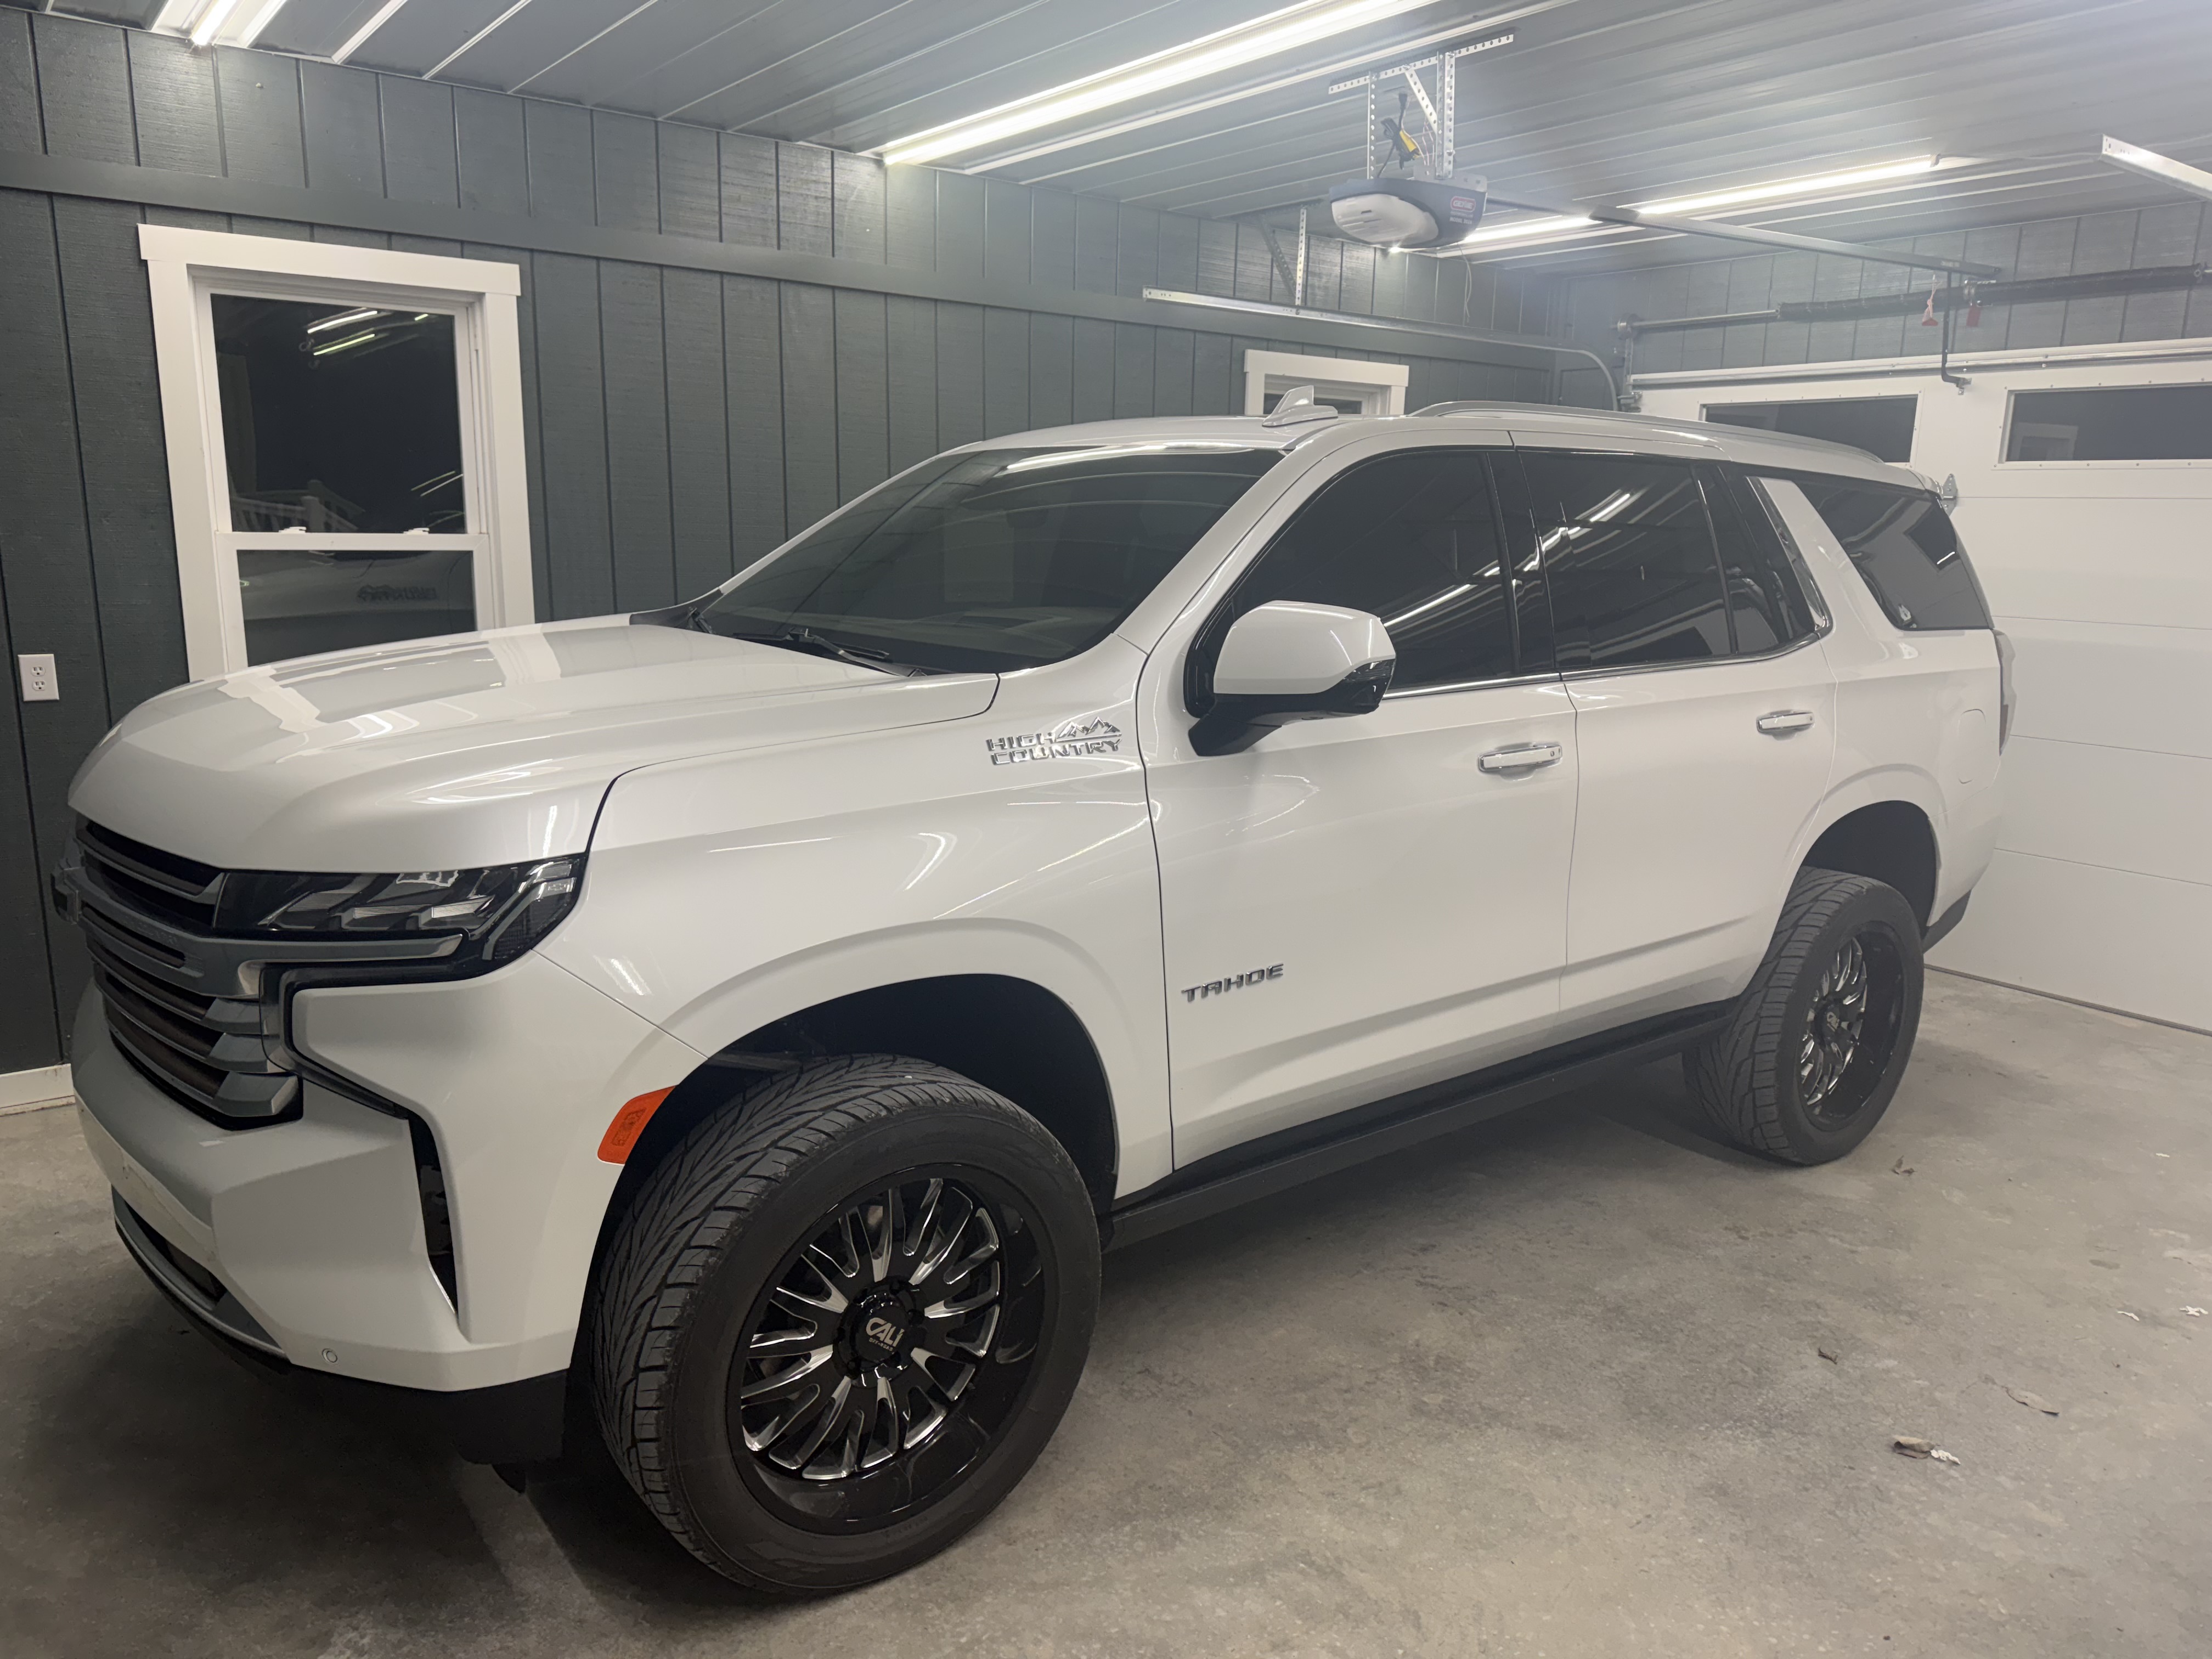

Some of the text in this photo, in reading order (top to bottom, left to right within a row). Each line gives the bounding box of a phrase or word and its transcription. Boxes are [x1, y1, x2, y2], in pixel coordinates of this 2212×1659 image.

[986, 732, 1056, 752] HIGH
[990, 738, 1122, 766] COUNTRY
[1181, 963, 1284, 1003] TAHOE
[865, 1317, 905, 1347] CALI
